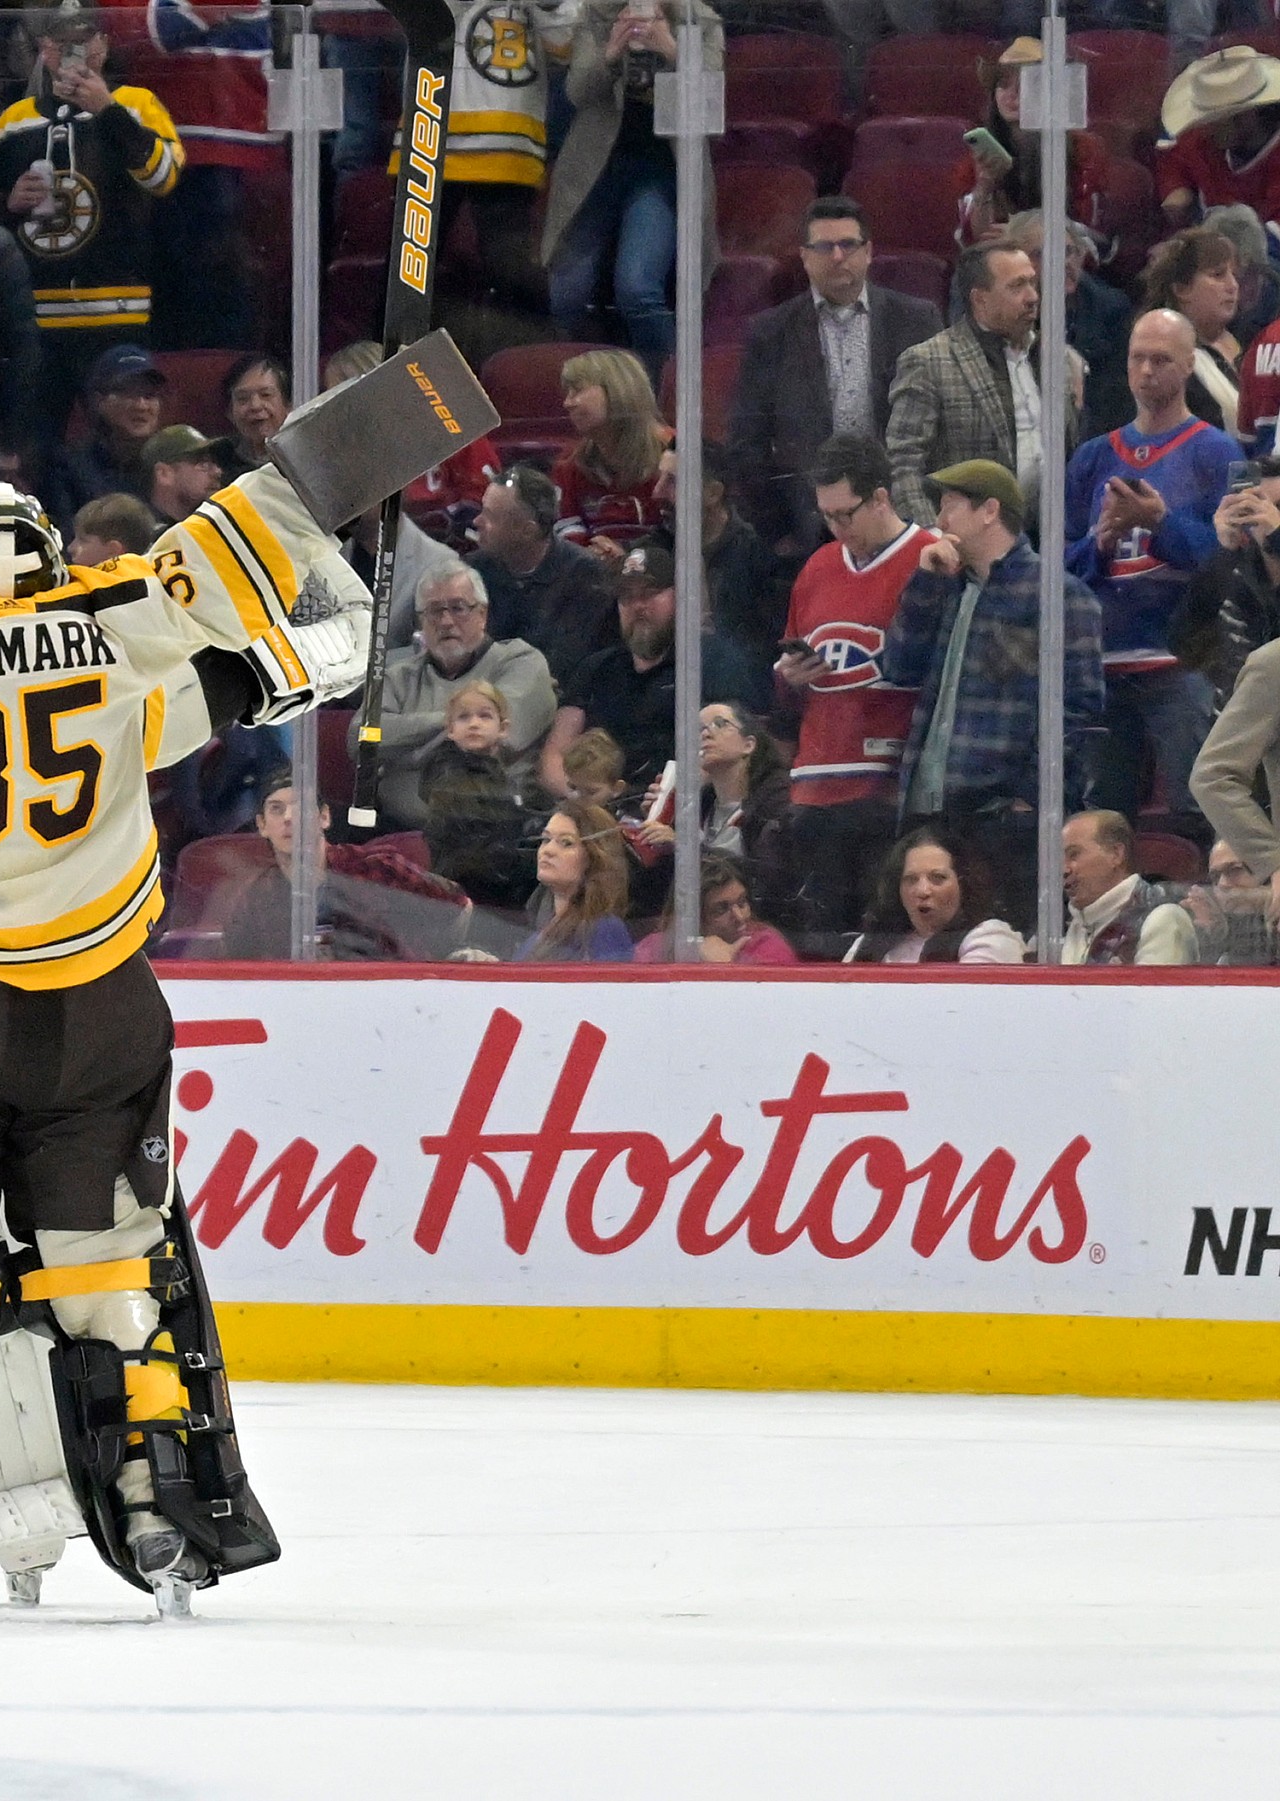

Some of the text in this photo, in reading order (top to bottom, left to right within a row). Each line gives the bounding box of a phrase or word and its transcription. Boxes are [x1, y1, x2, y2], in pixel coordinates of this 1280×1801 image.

[399, 66, 446, 295] BAUER
[405, 362, 462, 435] BAUER
[372, 551, 395, 681] HYPERLITE
[414, 1007, 1092, 1264] Hortons
